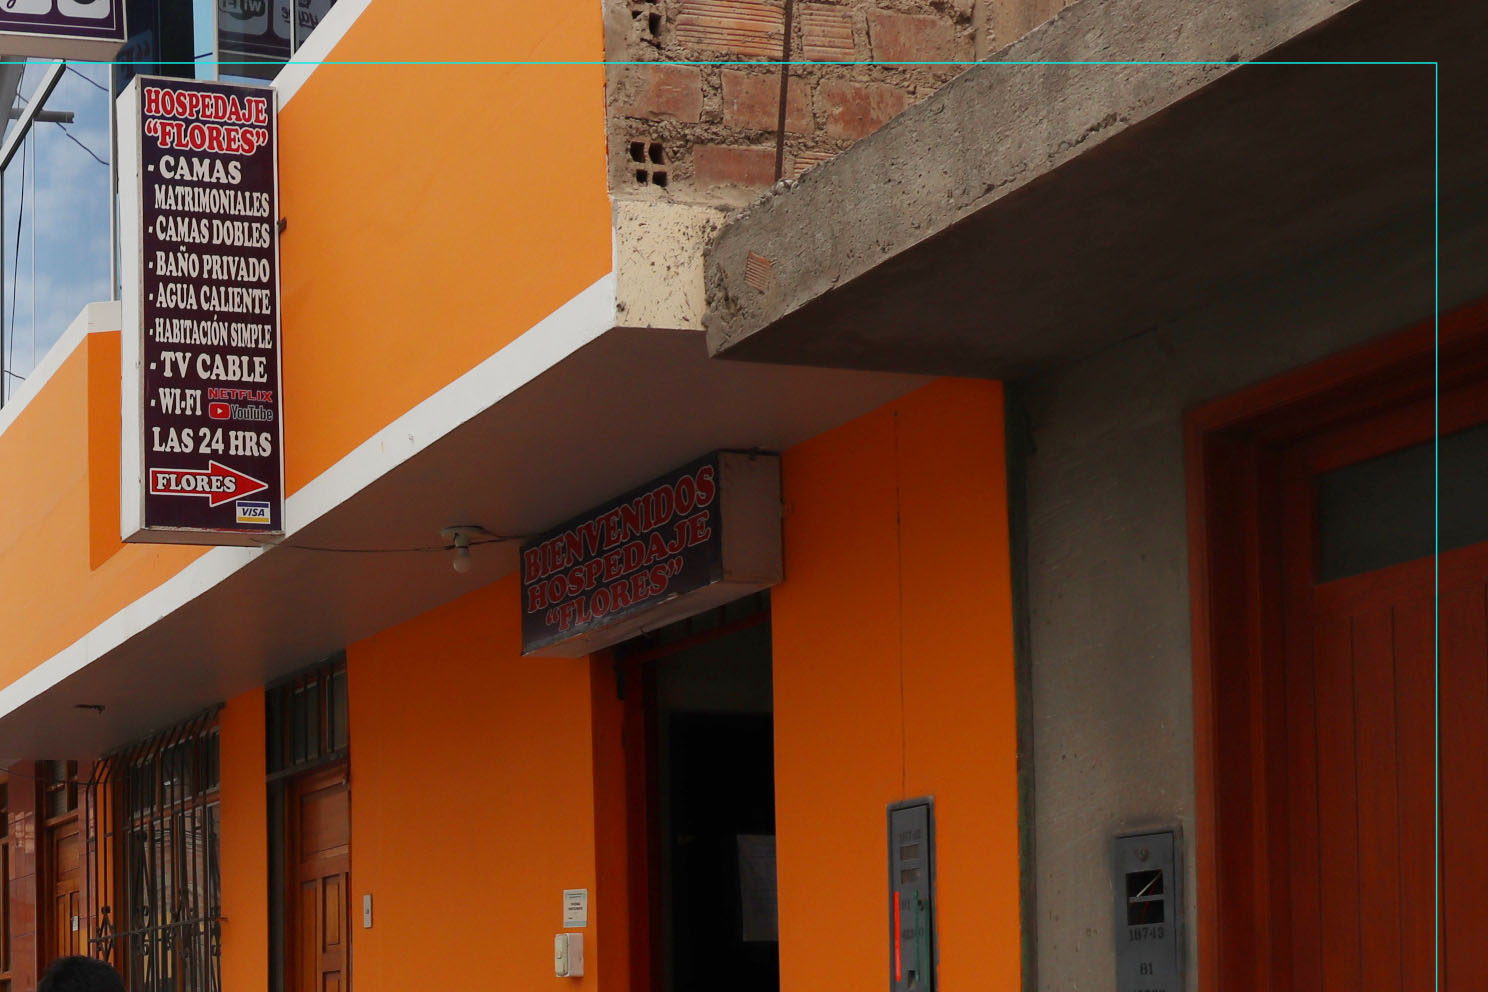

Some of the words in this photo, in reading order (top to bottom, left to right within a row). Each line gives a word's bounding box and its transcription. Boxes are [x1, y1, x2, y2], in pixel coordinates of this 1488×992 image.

[144, 87, 268, 125] HOSPEDAJE
[159, 155, 242, 184] CAMAS
[154, 184, 270, 218] MATRIMONIALES
[155, 215, 209, 244] CAMAS
[212, 219, 270, 249] DOBLES
[155, 245, 200, 278] BAÑO
[202, 254, 270, 283] PRIVADO
[155, 282, 198, 310] AGUA
[200, 285, 271, 314] CALIENTE
[155, 315, 228, 346] HABITACIÓN
[230, 321, 272, 349] SIMPLE
[160, 351, 192, 378] TV
[196, 353, 268, 383] CABLE
[158, 387, 202, 416] WI-FI
[207, 387, 273, 403] NETFLIX
[230, 403, 273, 421] YouTube
[152, 426, 194, 453] LAS
[198, 428, 224, 455] 24
[228, 430, 272, 457] HRS
[156, 473, 237, 493] FLORES
[240, 507, 266, 518] VISA
[524, 465, 716, 585] BIENVENIDOS
[527, 510, 712, 614] HOSPEDAJE
